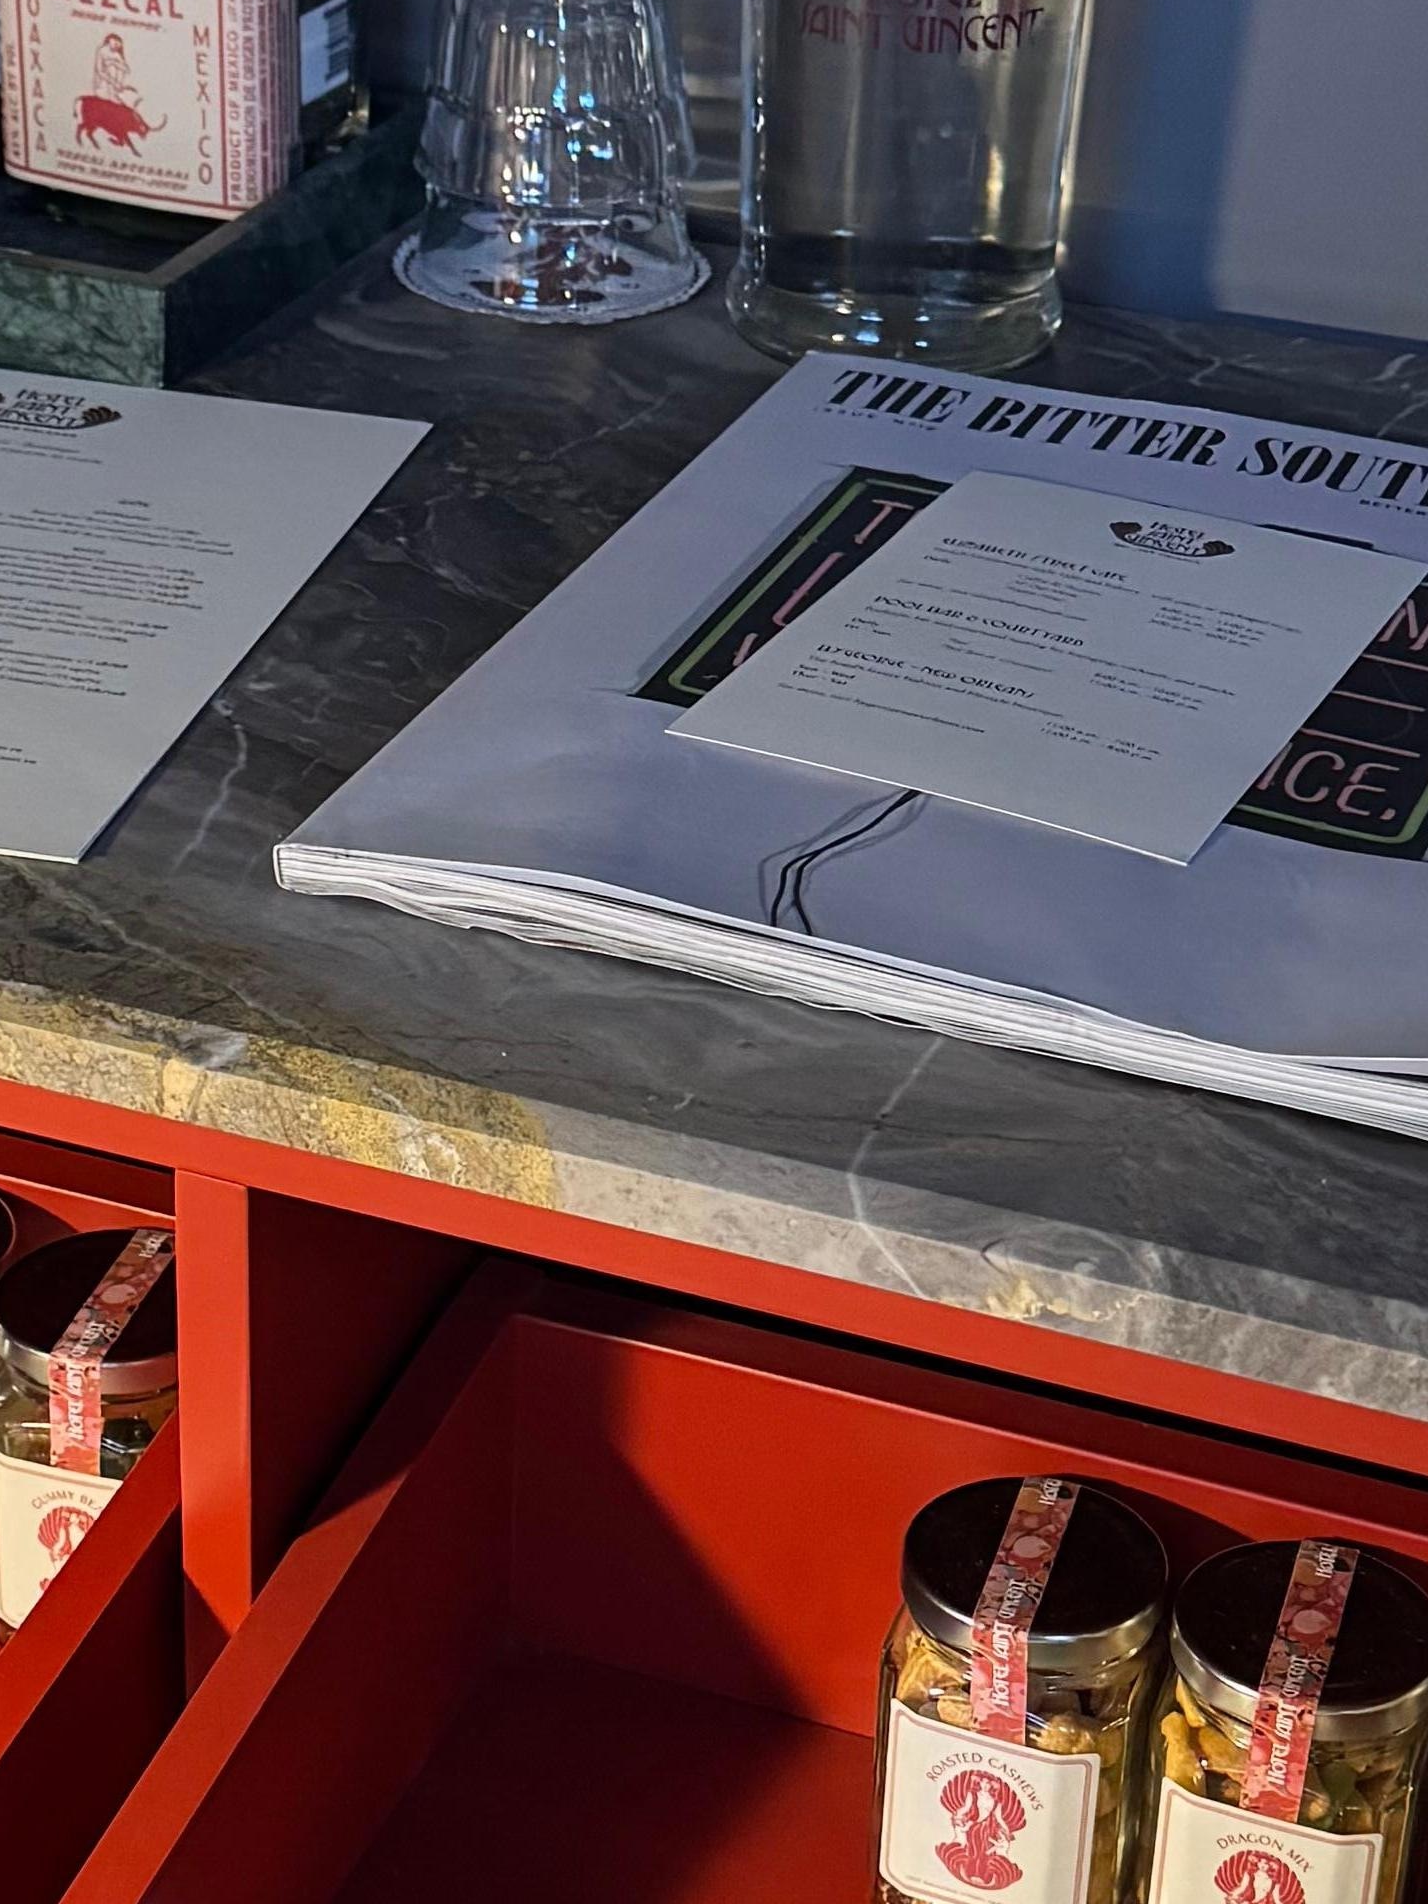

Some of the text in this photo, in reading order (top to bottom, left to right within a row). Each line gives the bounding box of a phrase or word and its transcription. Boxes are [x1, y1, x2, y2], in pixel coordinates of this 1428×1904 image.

[799, 0, 887, 40] SAINT
[901, 6, 1044, 52] VINCENT
[225, 29, 240, 92] MEXICO
[191, 24, 214, 187] MEXICO
[229, 127, 243, 203] PRODUCT
[828, 369, 971, 425] THE
[967, 395, 1228, 468] BITTER
[1358, 497, 1428, 521] BETTER
[30, 1489, 77, 1512] GUMMY
[925, 1752, 1044, 1812] ROASTED CASHEWS
[1216, 1832, 1314, 1875] DRAGON MIX
